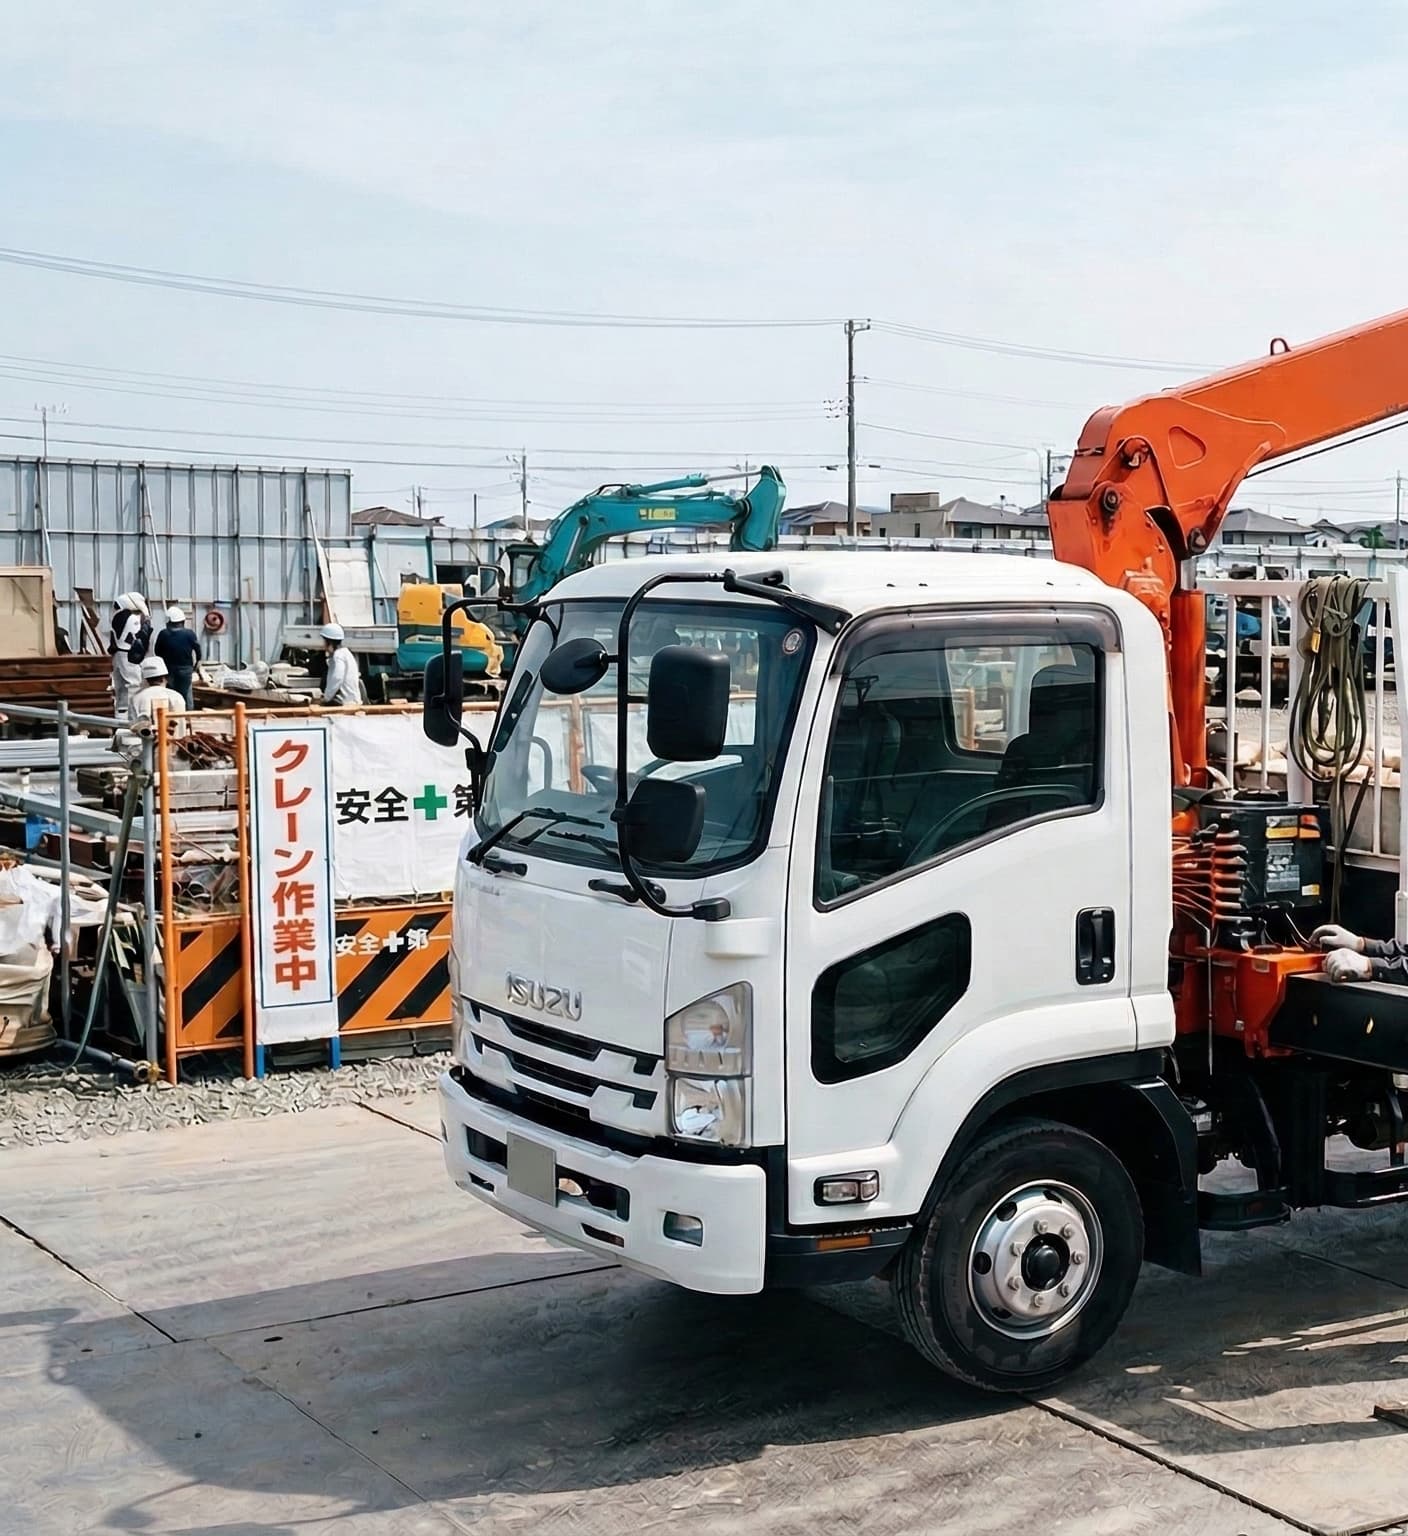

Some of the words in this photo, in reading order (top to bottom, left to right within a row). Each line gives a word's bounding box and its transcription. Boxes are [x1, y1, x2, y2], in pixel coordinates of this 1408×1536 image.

[336, 786, 408, 825] 安全
[271, 739, 317, 991] クレーン作業中
[335, 931, 380, 957] 安全
[506, 973, 582, 1021] ISUZU
